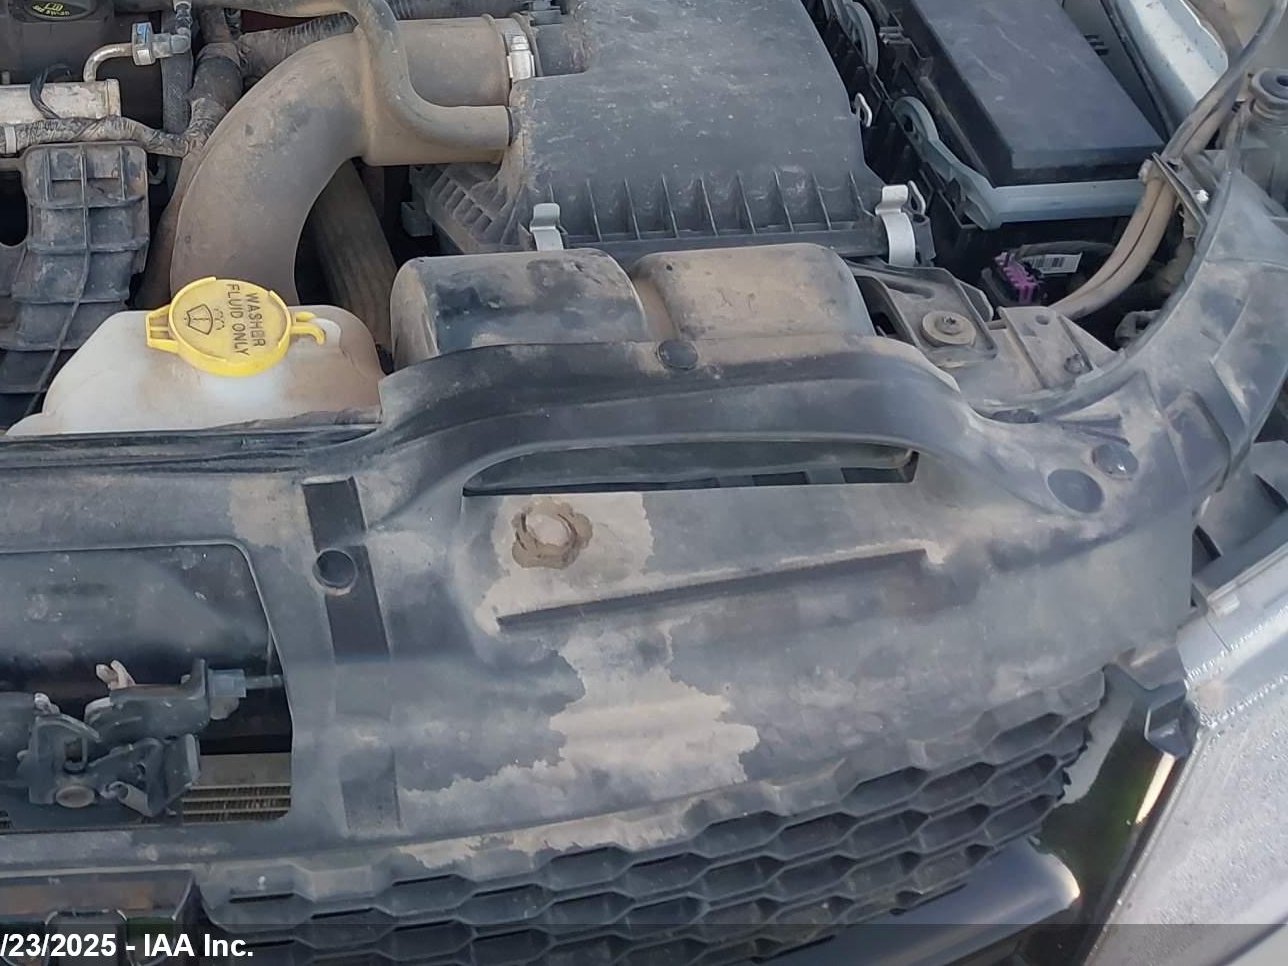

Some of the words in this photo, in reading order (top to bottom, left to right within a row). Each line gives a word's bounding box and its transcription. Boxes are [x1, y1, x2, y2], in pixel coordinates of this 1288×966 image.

[226, 283, 244, 319] FLUID
[245, 292, 266, 347] WASHER
[231, 322, 250, 356] ONLY
